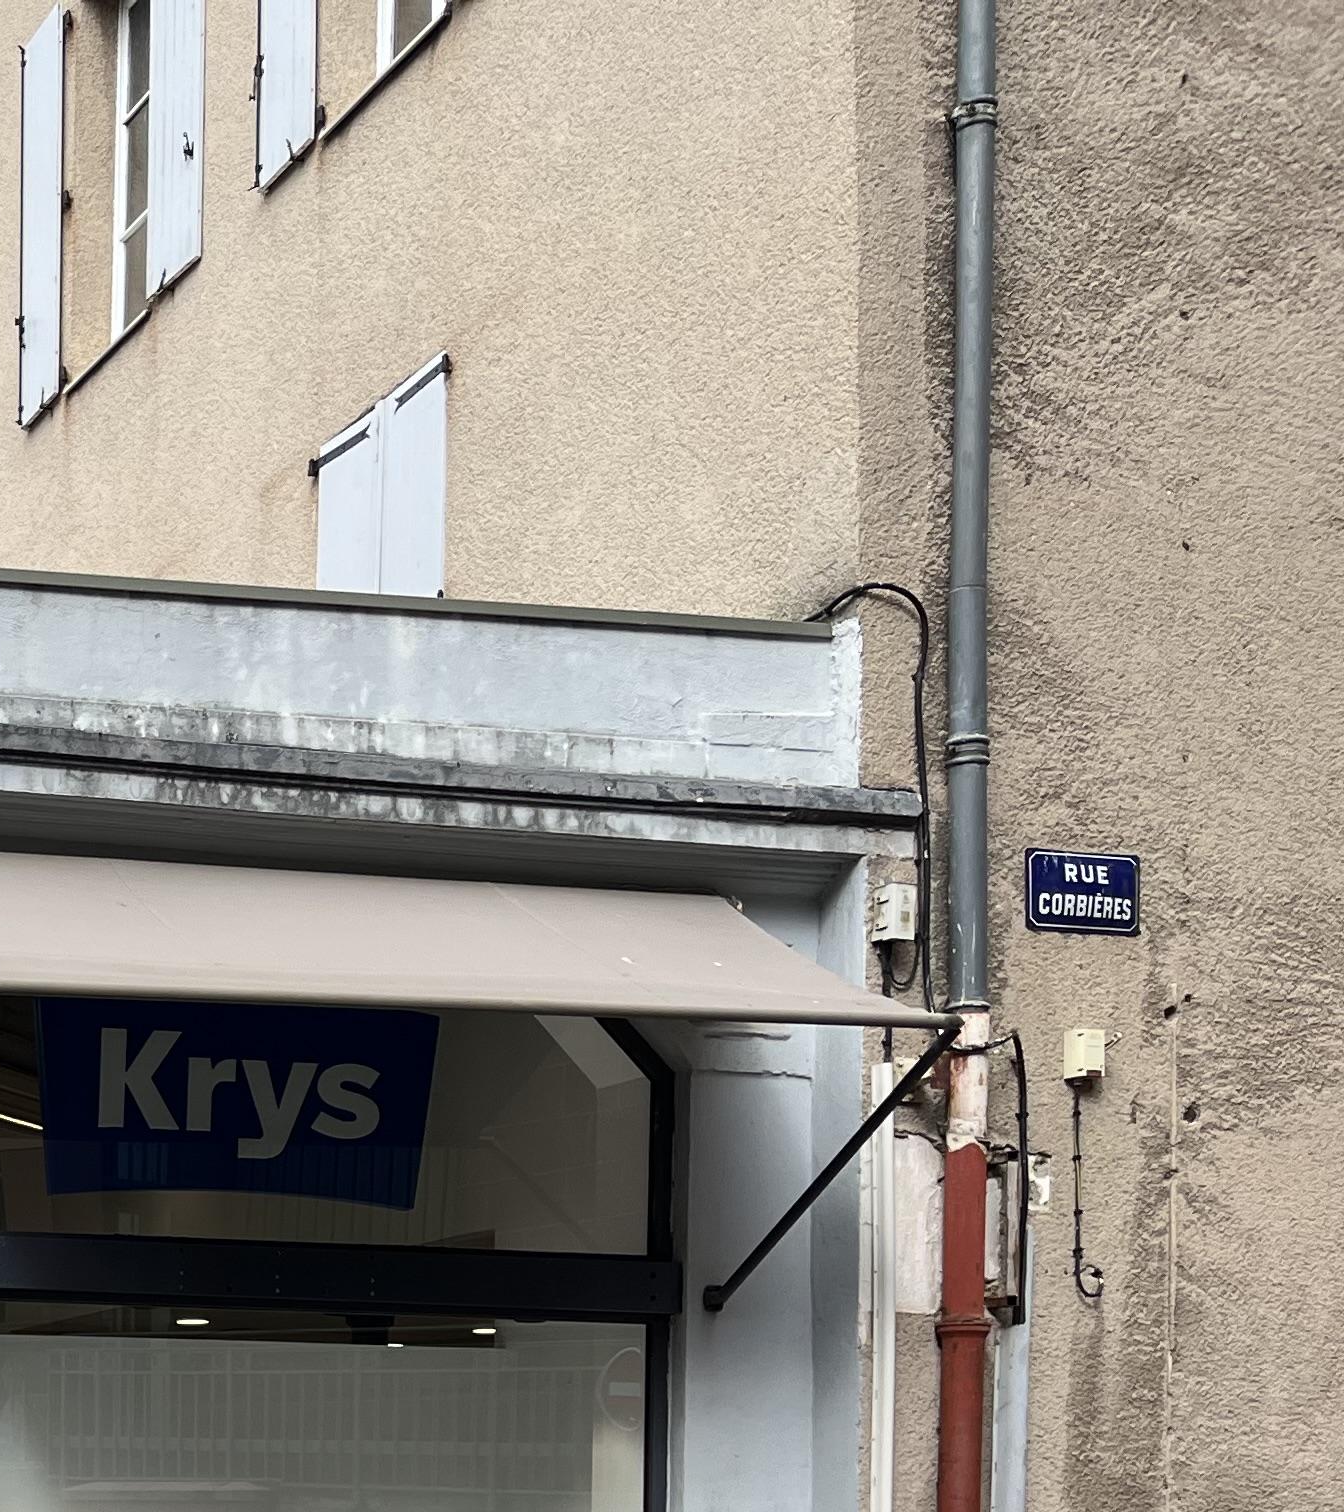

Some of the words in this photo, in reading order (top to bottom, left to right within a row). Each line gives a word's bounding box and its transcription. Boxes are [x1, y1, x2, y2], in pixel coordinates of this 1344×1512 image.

[1064, 863, 1110, 885] RUE
[1038, 892, 1132, 921] CORBIÈRES
[97, 1027, 381, 1159] Krys
